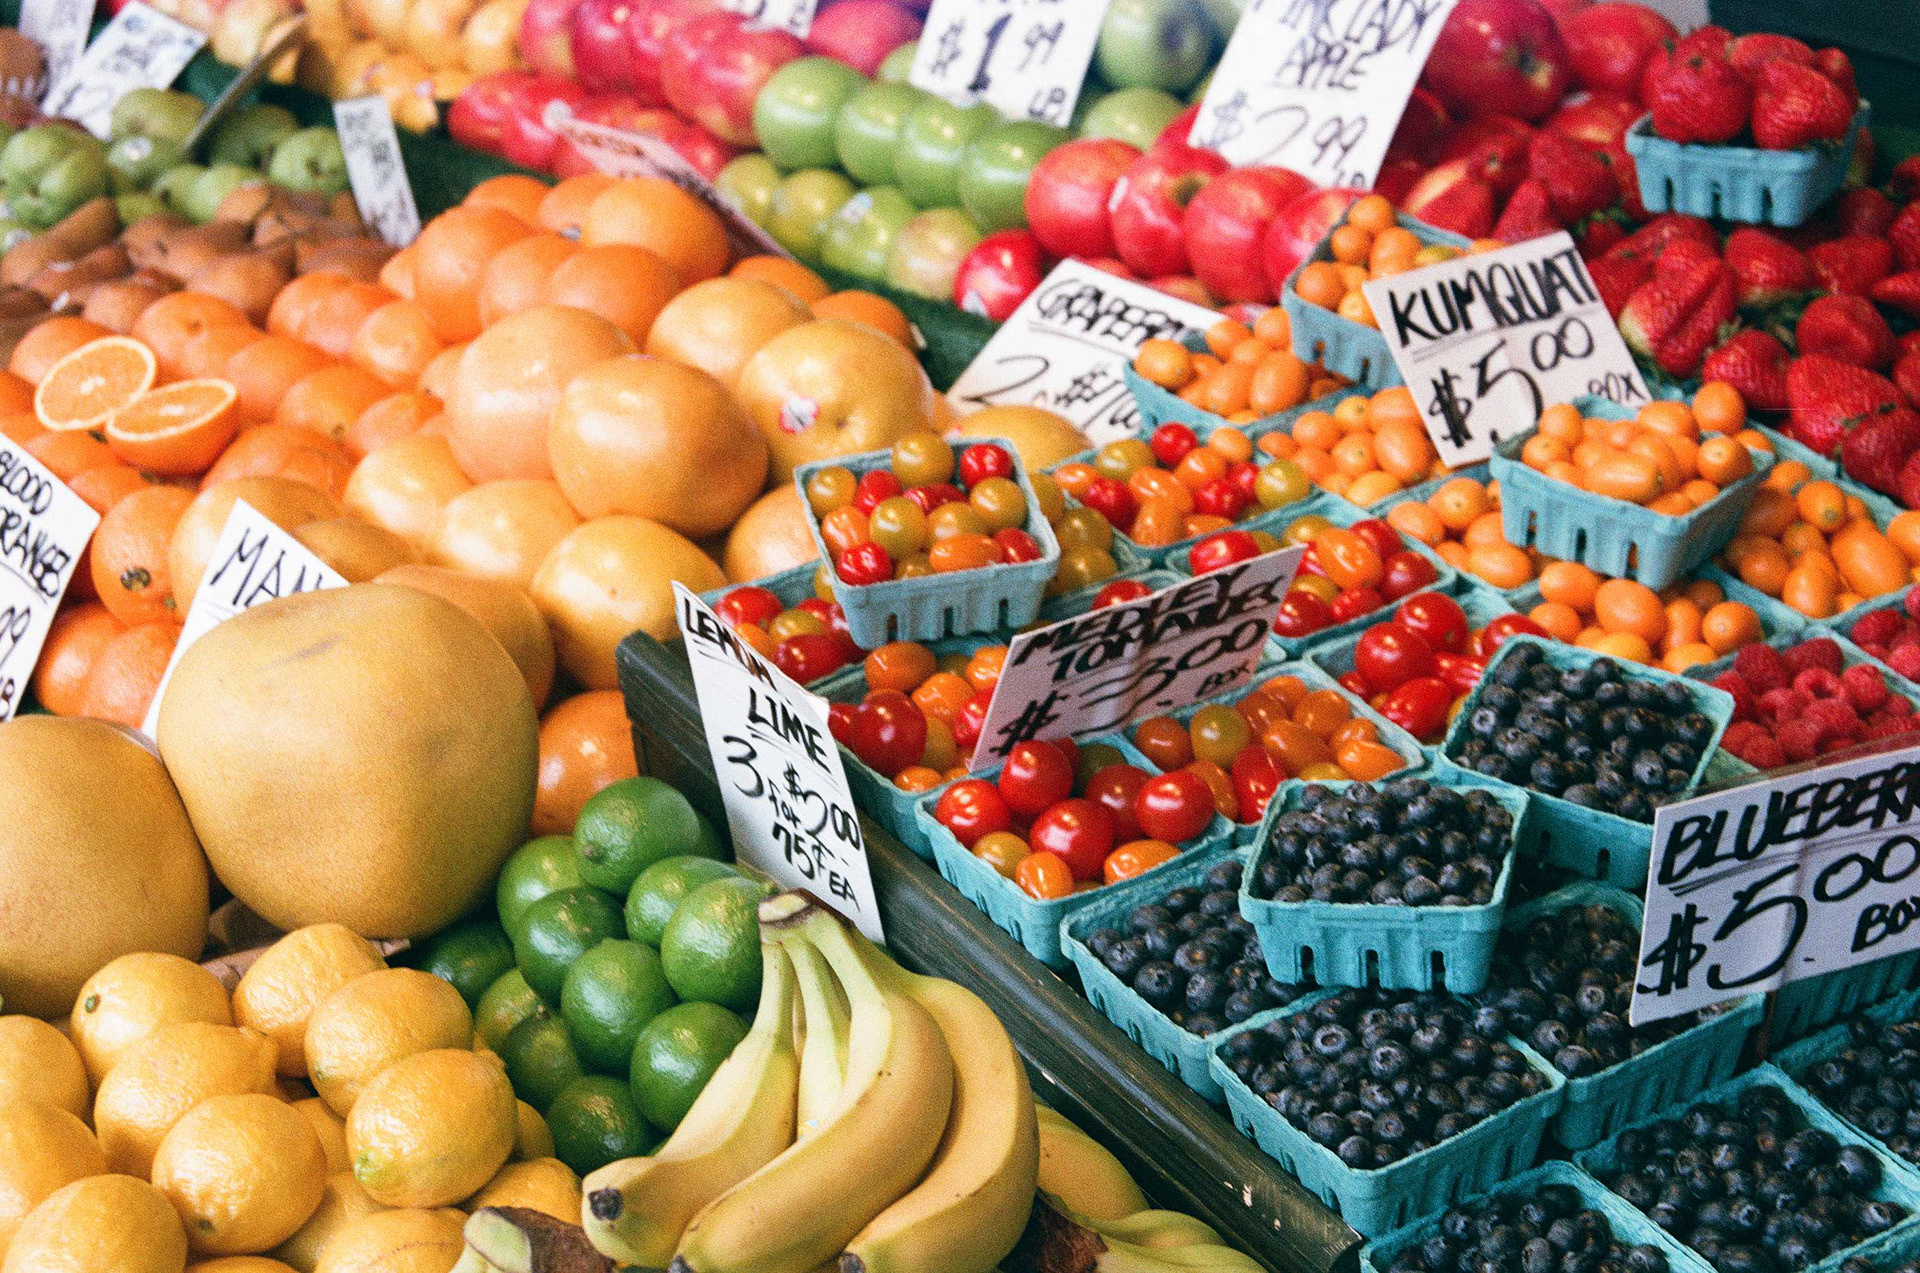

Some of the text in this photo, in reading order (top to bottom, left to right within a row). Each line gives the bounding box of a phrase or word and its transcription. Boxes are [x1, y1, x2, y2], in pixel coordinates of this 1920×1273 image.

[1388, 250, 1597, 347] KUMQUAT
[684, 597, 779, 693] LEMON
[1012, 562, 1252, 667] MEDLEY
[722, 735, 764, 798] 3
[748, 686, 833, 774] LIME
[828, 870, 861, 913] EA
